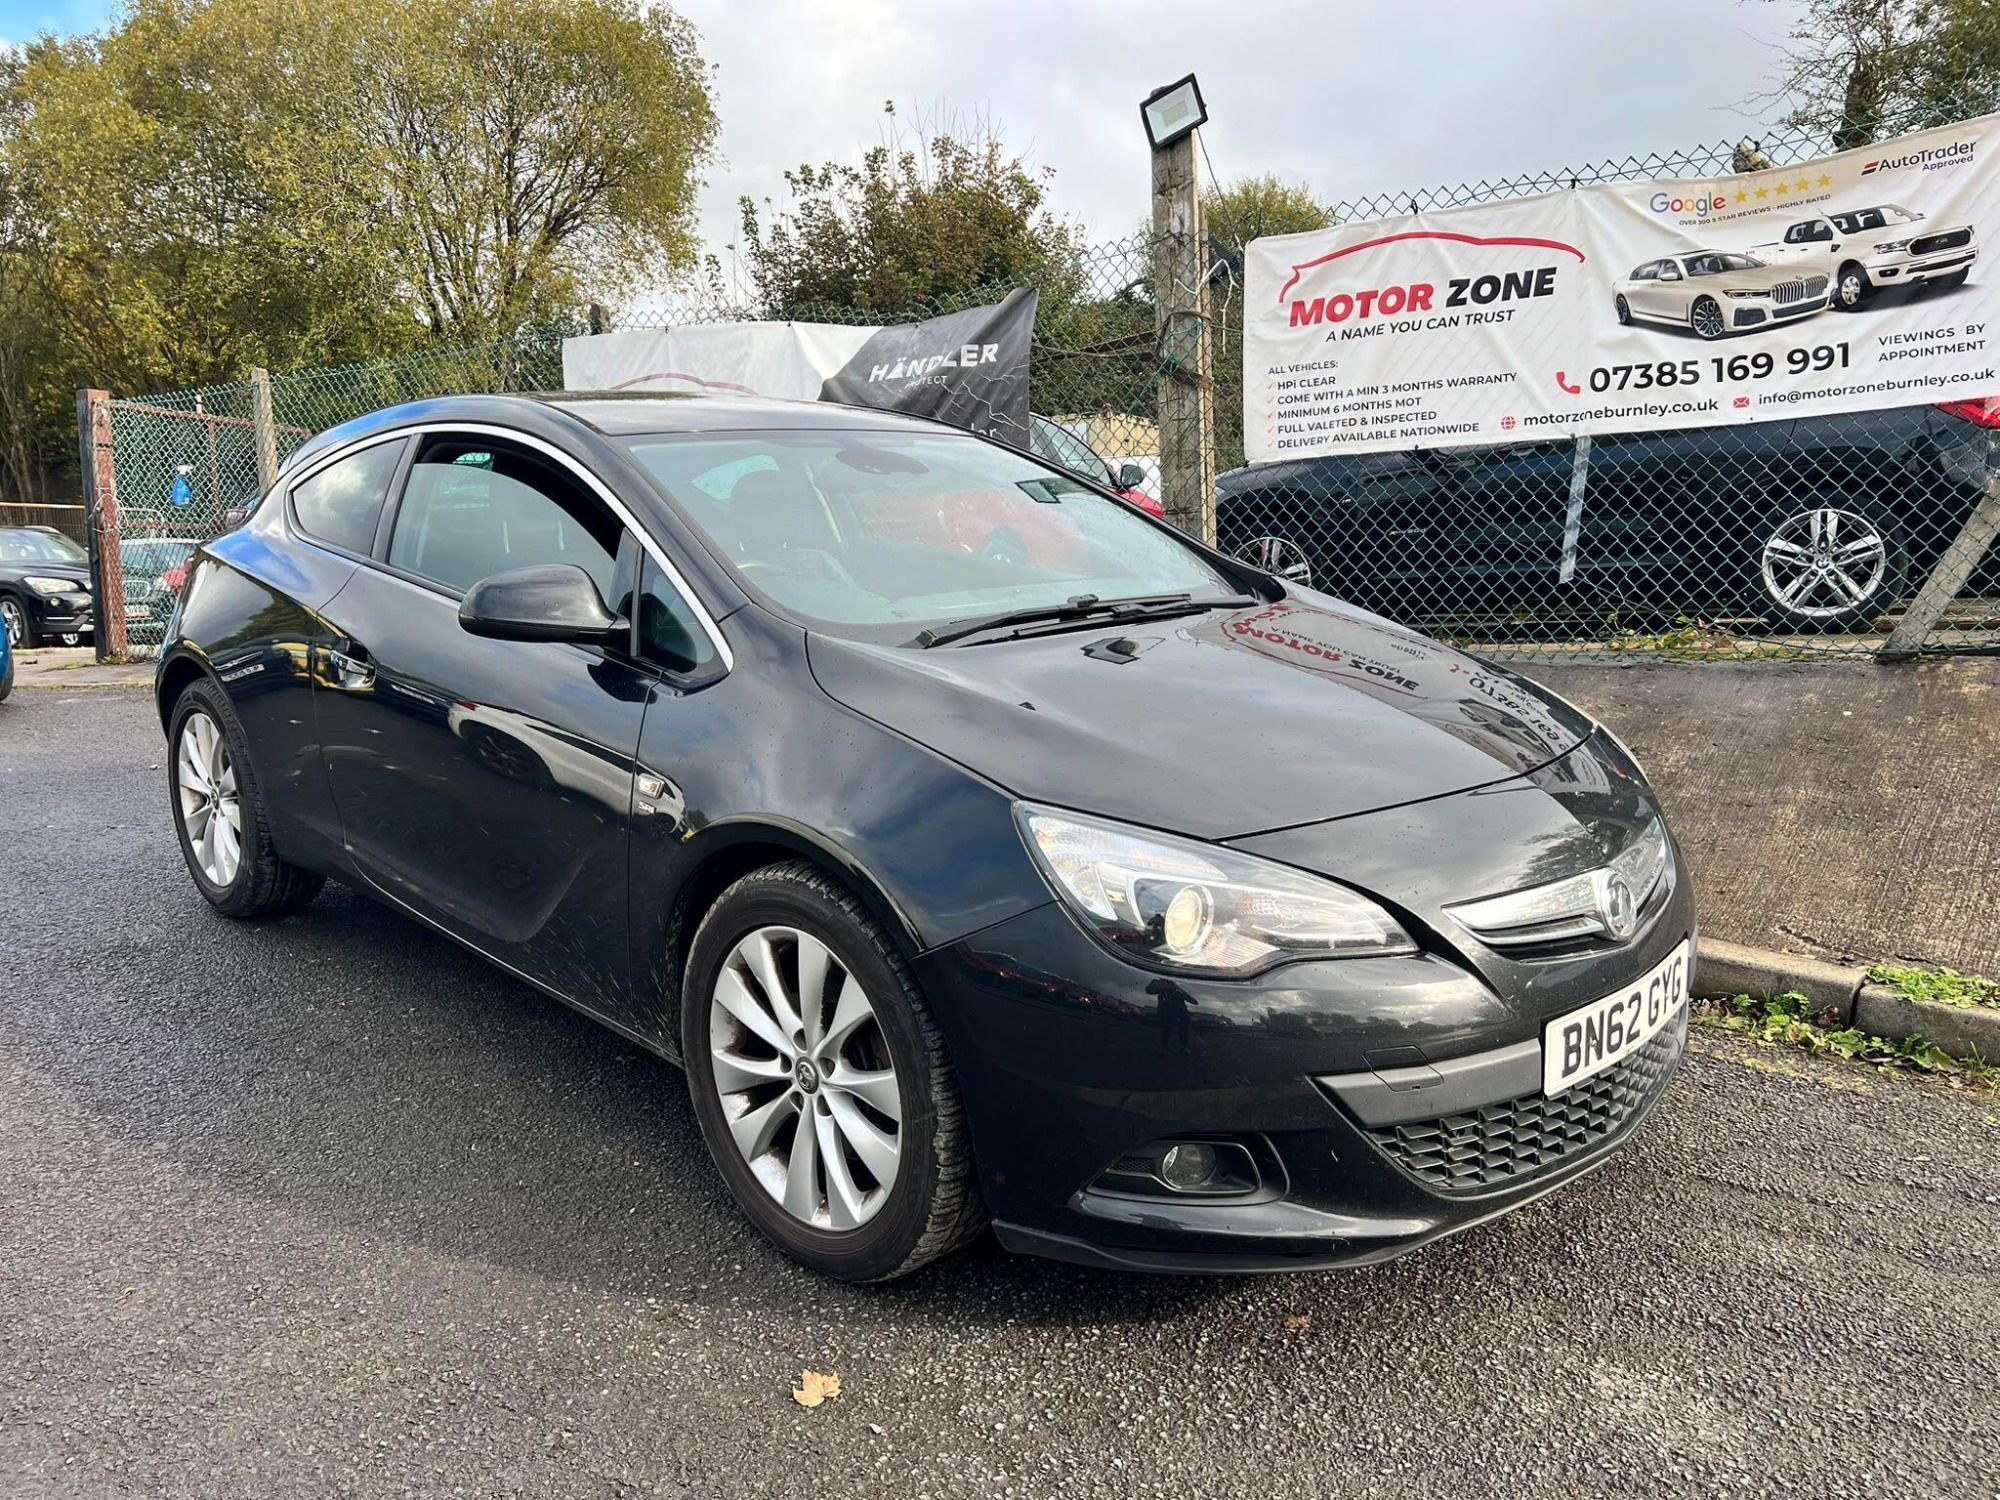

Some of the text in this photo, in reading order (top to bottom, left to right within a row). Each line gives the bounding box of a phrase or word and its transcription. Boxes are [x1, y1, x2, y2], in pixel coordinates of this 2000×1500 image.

[1879, 140, 1977, 172] AutoTrader
[1922, 154, 1974, 172] Approved
[1650, 192, 1726, 217] Google
[1718, 214, 1737, 222] STAR
[1738, 206, 1771, 217] REVIEWS
[1777, 200, 1804, 209] HIGHLY
[1806, 194, 1831, 205] RATED
[1289, 267, 1557, 327] MOTOR ZONE
[1326, 309, 1516, 342] A NAME YOU CAN TRUST
[1878, 323, 1987, 347] VIEWINGS BY
[868, 343, 999, 383] HÄNDLER
[1878, 339, 1987, 363] APPOINTMENT
[1268, 360, 1338, 375] ALL VEHICLES:
[1589, 341, 1851, 394] 07385 169 991
[1277, 376, 1336, 391] HPi CLEAR
[1277, 373, 1518, 405] COME WITH A MIN 3 MONTHS WARRANTY
[1758, 367, 1996, 407] info@motorzoneburnley.co.uk
[1277, 397, 1422, 420] MINIMUM 6 MONTHS MOT
[1277, 410, 1437, 434] FULL VALETED & INSPECTED
[1277, 422, 1480, 449] DELIVERY AVAILABLE NATIONWIDE
[1561, 955, 1682, 1079] BN62 GYG
